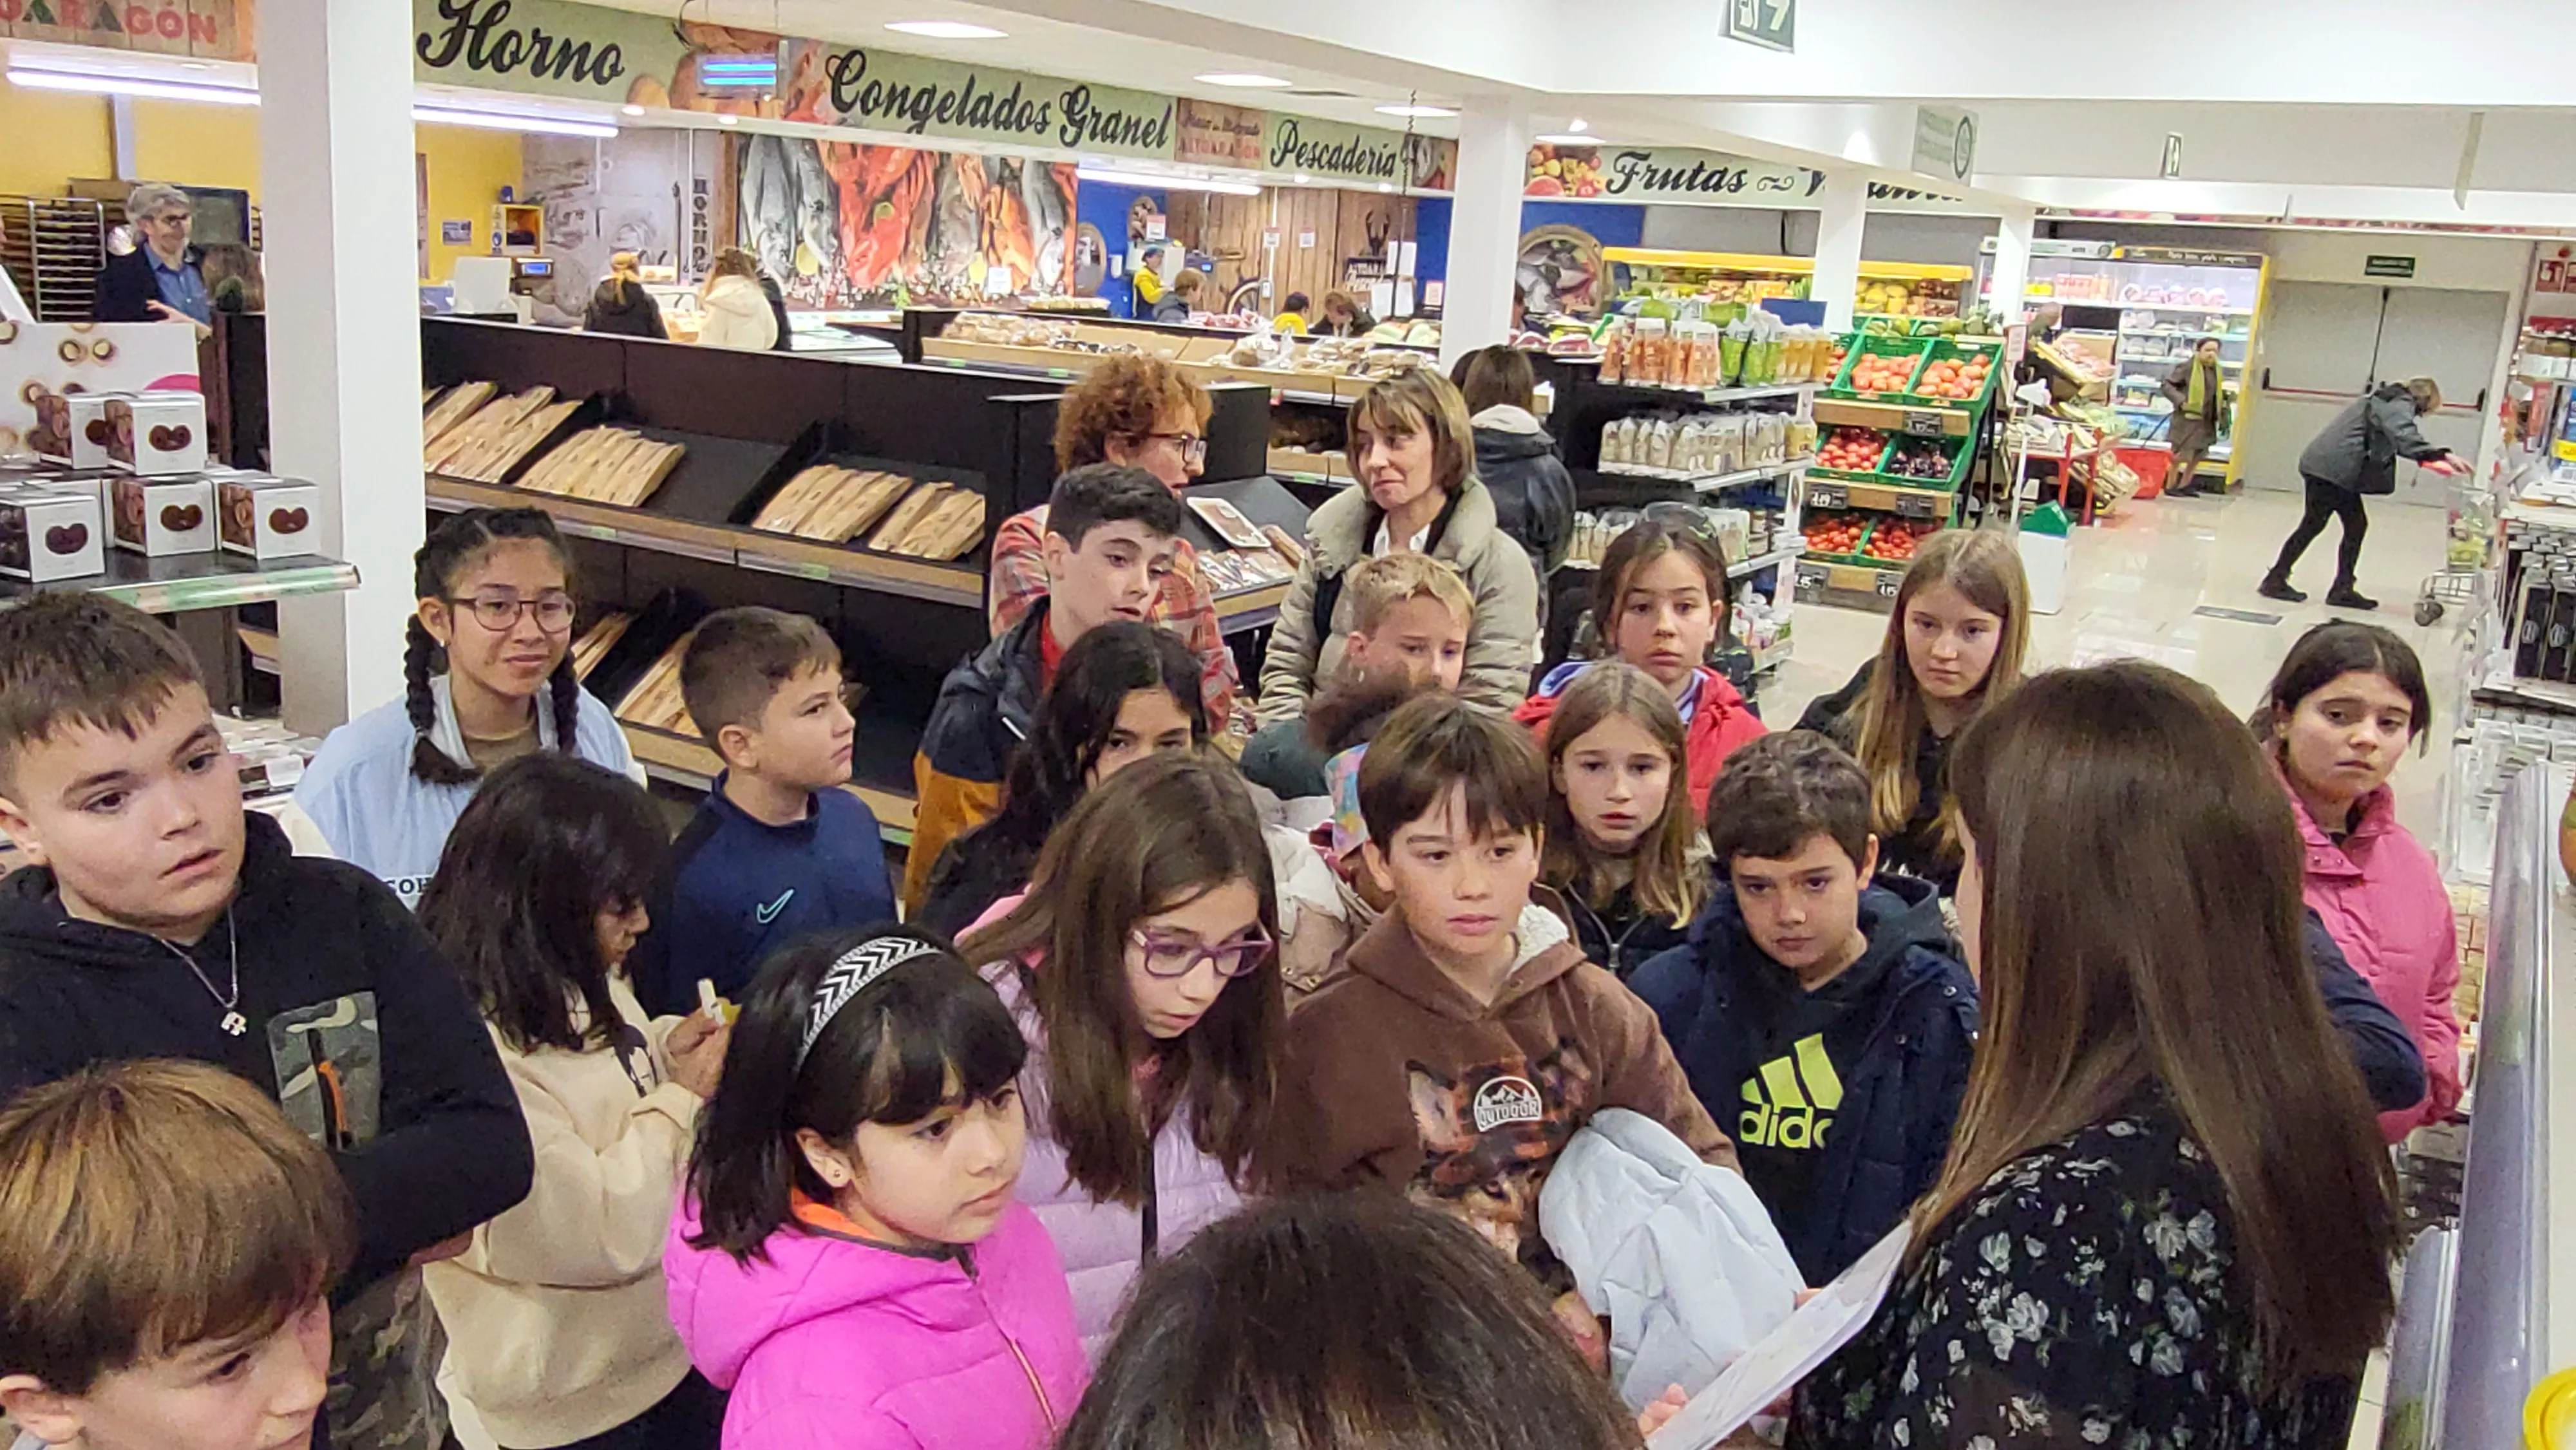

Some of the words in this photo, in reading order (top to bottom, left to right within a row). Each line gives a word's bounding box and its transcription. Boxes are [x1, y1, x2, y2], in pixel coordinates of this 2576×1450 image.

[415, 0, 625, 86] Horno
[825, 48, 1052, 134] Congelados
[1059, 84, 1173, 149] Granel
[1269, 118, 1397, 178] Pescadería
[1605, 151, 1748, 194] Frutas
[1479, 1100, 1539, 1127] OUTDOOR
